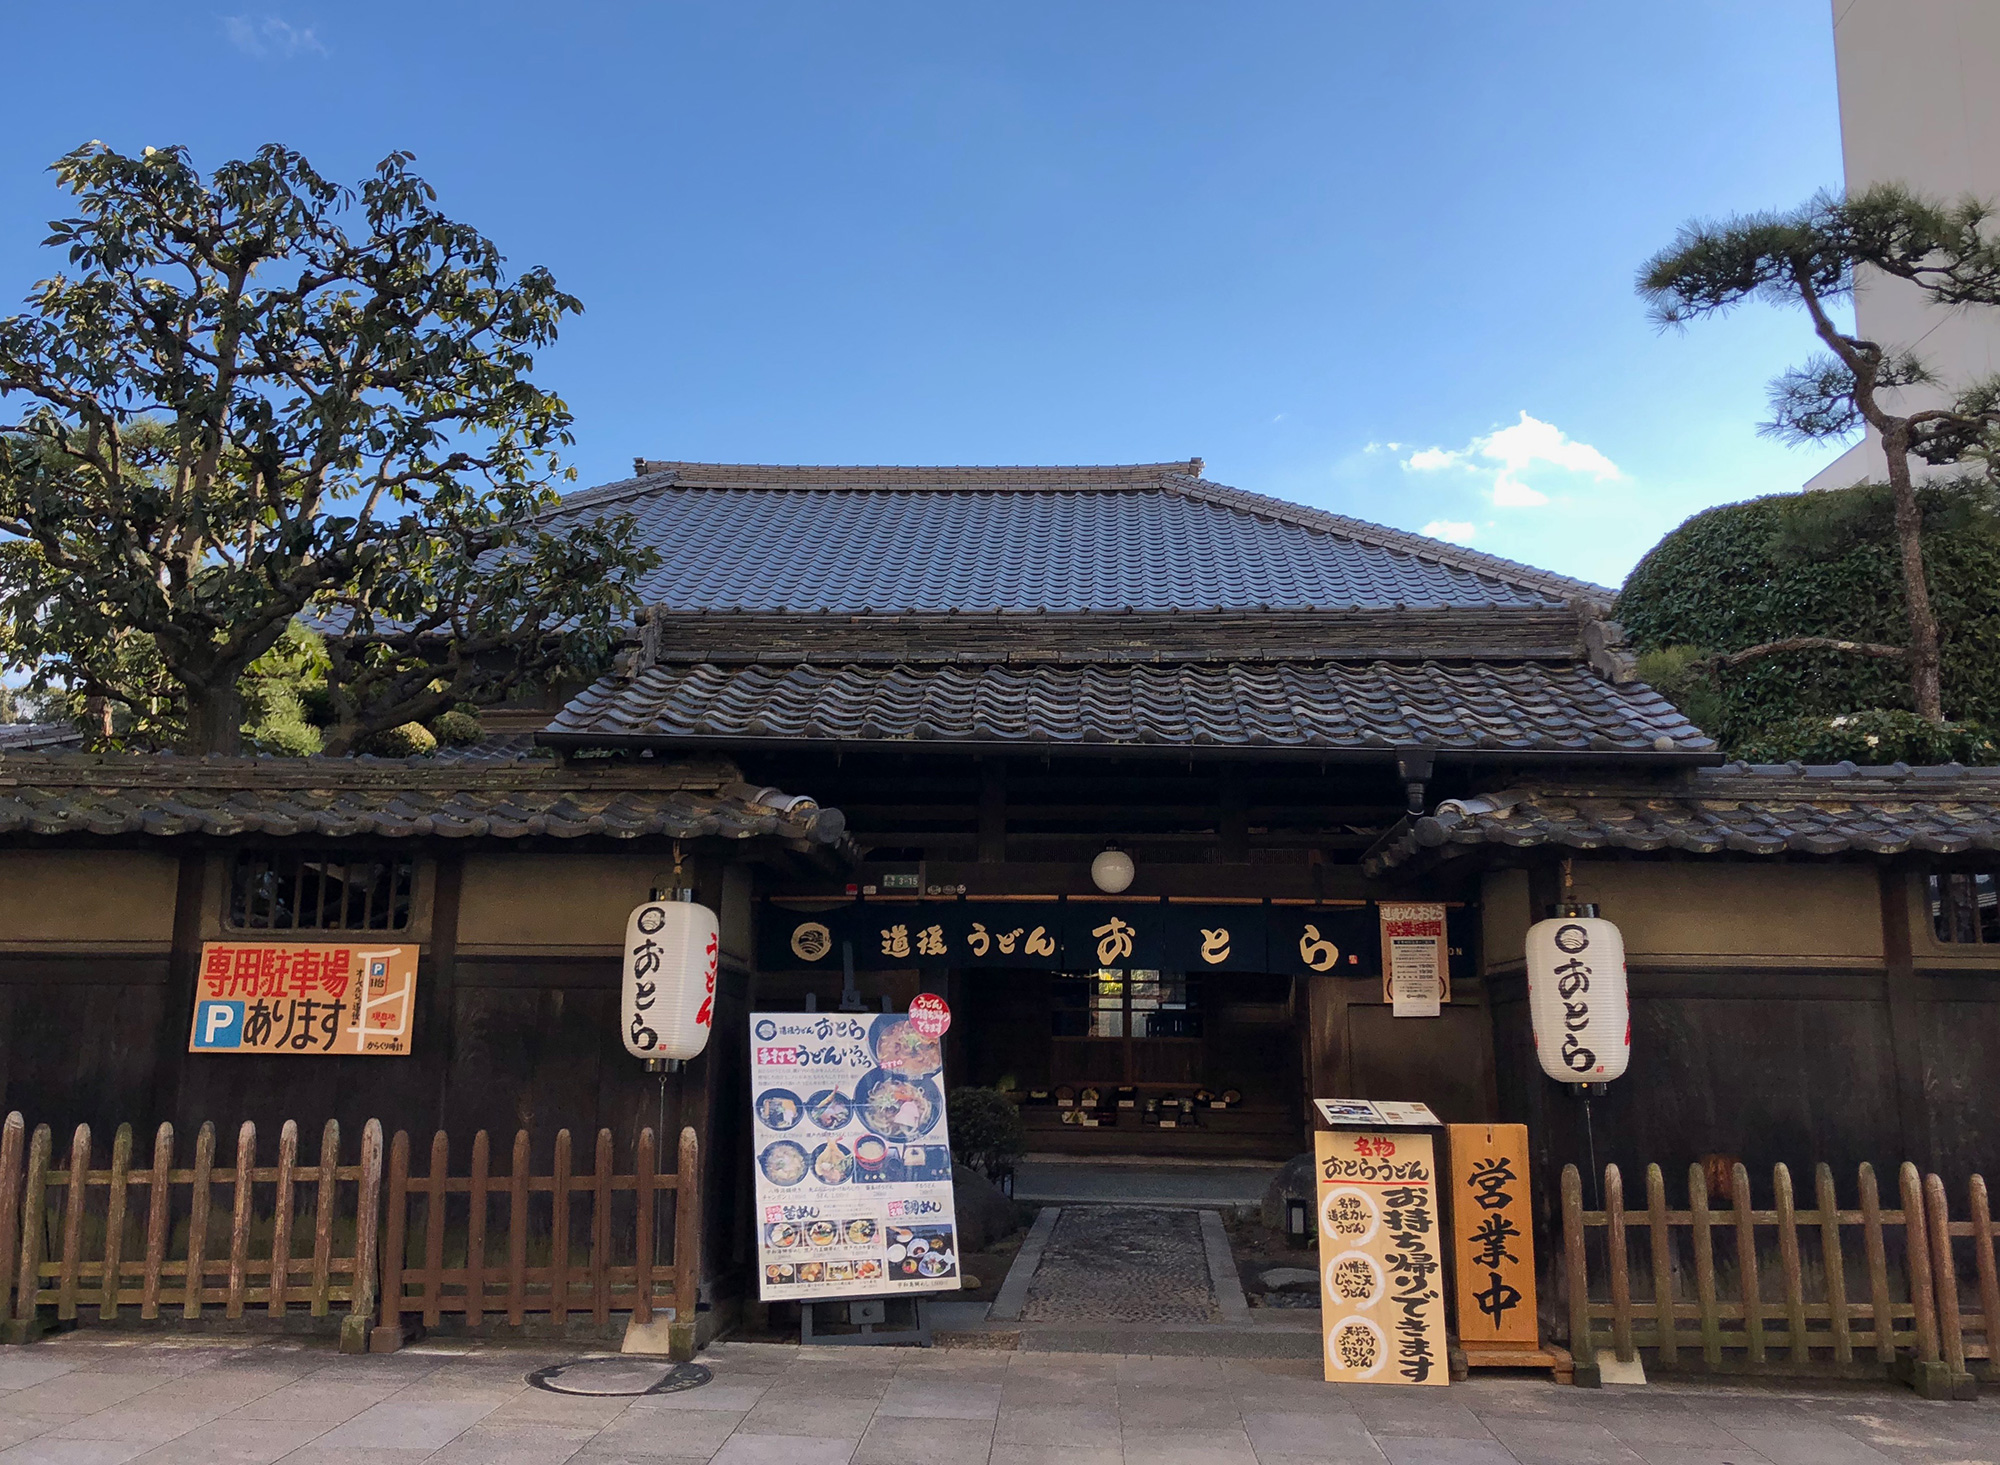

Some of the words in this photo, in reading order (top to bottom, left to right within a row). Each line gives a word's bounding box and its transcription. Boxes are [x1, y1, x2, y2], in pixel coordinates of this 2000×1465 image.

[1386, 921, 1441, 937] 営業時間
[203, 946, 351, 998] 専用駐車場
[373, 964, 383, 974] P
[631, 938, 665, 1051] おとら
[917, 996, 943, 1010] うどん
[371, 1011, 396, 1022] 現在地
[910, 1008, 950, 1023] お持ち帰り
[1554, 958, 1596, 1073] おとら
[205, 1004, 234, 1043] P
[243, 998, 347, 1052] あります
[815, 1018, 866, 1040] おとら
[917, 1020, 942, 1034] できます
[367, 1041, 403, 1051] からくり時計
[1353, 1137, 1396, 1157] 名物
[1322, 1156, 1429, 1181] おとらうどん
[904, 1200, 942, 1216] 鯛めし
[1338, 1198, 1361, 1209] 名物
[783, 1205, 820, 1221] 釜めし
[1327, 1209, 1373, 1222] 道後カレー
[1336, 1221, 1366, 1234] うどん
[1467, 1157, 1523, 1331] 営業中
[1339, 1261, 1370, 1274] 八幡浜
[1335, 1273, 1374, 1287] じゃこ天
[1381, 1187, 1439, 1383] お持ち帰りできます
[1341, 1285, 1371, 1299] うどん
[1344, 1326, 1371, 1336] 天ぷら
[1339, 1336, 1376, 1347] ぶっかけ
[1344, 1356, 1373, 1369] うどん
